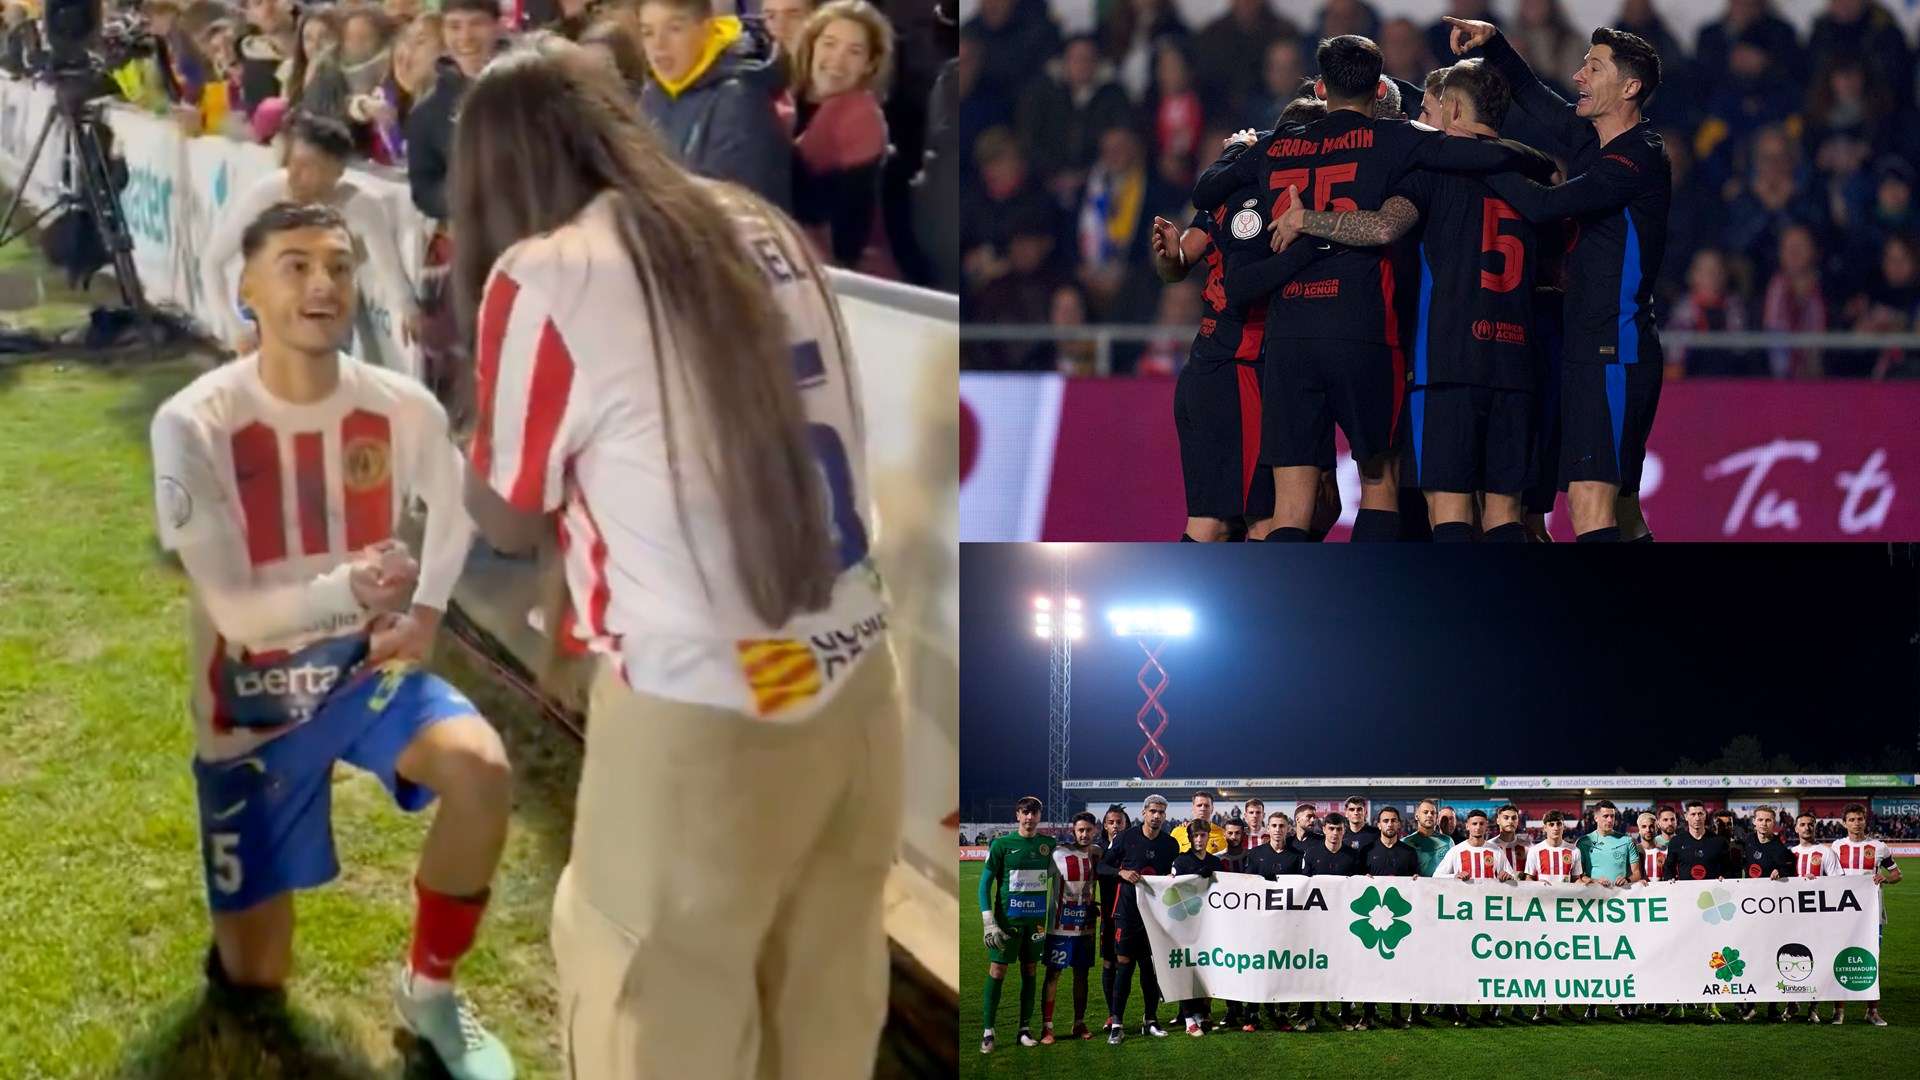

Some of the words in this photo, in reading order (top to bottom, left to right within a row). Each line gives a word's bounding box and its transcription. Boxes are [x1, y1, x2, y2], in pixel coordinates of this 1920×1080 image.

[1480, 197, 1525, 293] 5
[1704, 436, 1821, 536] Tu
[211, 832, 243, 895] 5
[1010, 898, 1035, 908] Berta
[1208, 887, 1328, 911] conELA
[1437, 894, 1473, 921] La
[1485, 895, 1547, 922] ELA
[1555, 896, 1669, 923] EXISTE
[1741, 889, 1863, 914] conELA
[1050, 950, 1068, 965] 22
[1471, 932, 1636, 961] ConócELA
[1168, 946, 1329, 974] #LaCopaMola
[1847, 956, 1863, 964] ELA
[1478, 978, 1546, 998] TEAM
[1555, 973, 1636, 998] UNZUÉ
[1702, 983, 1757, 996] ARAELA
